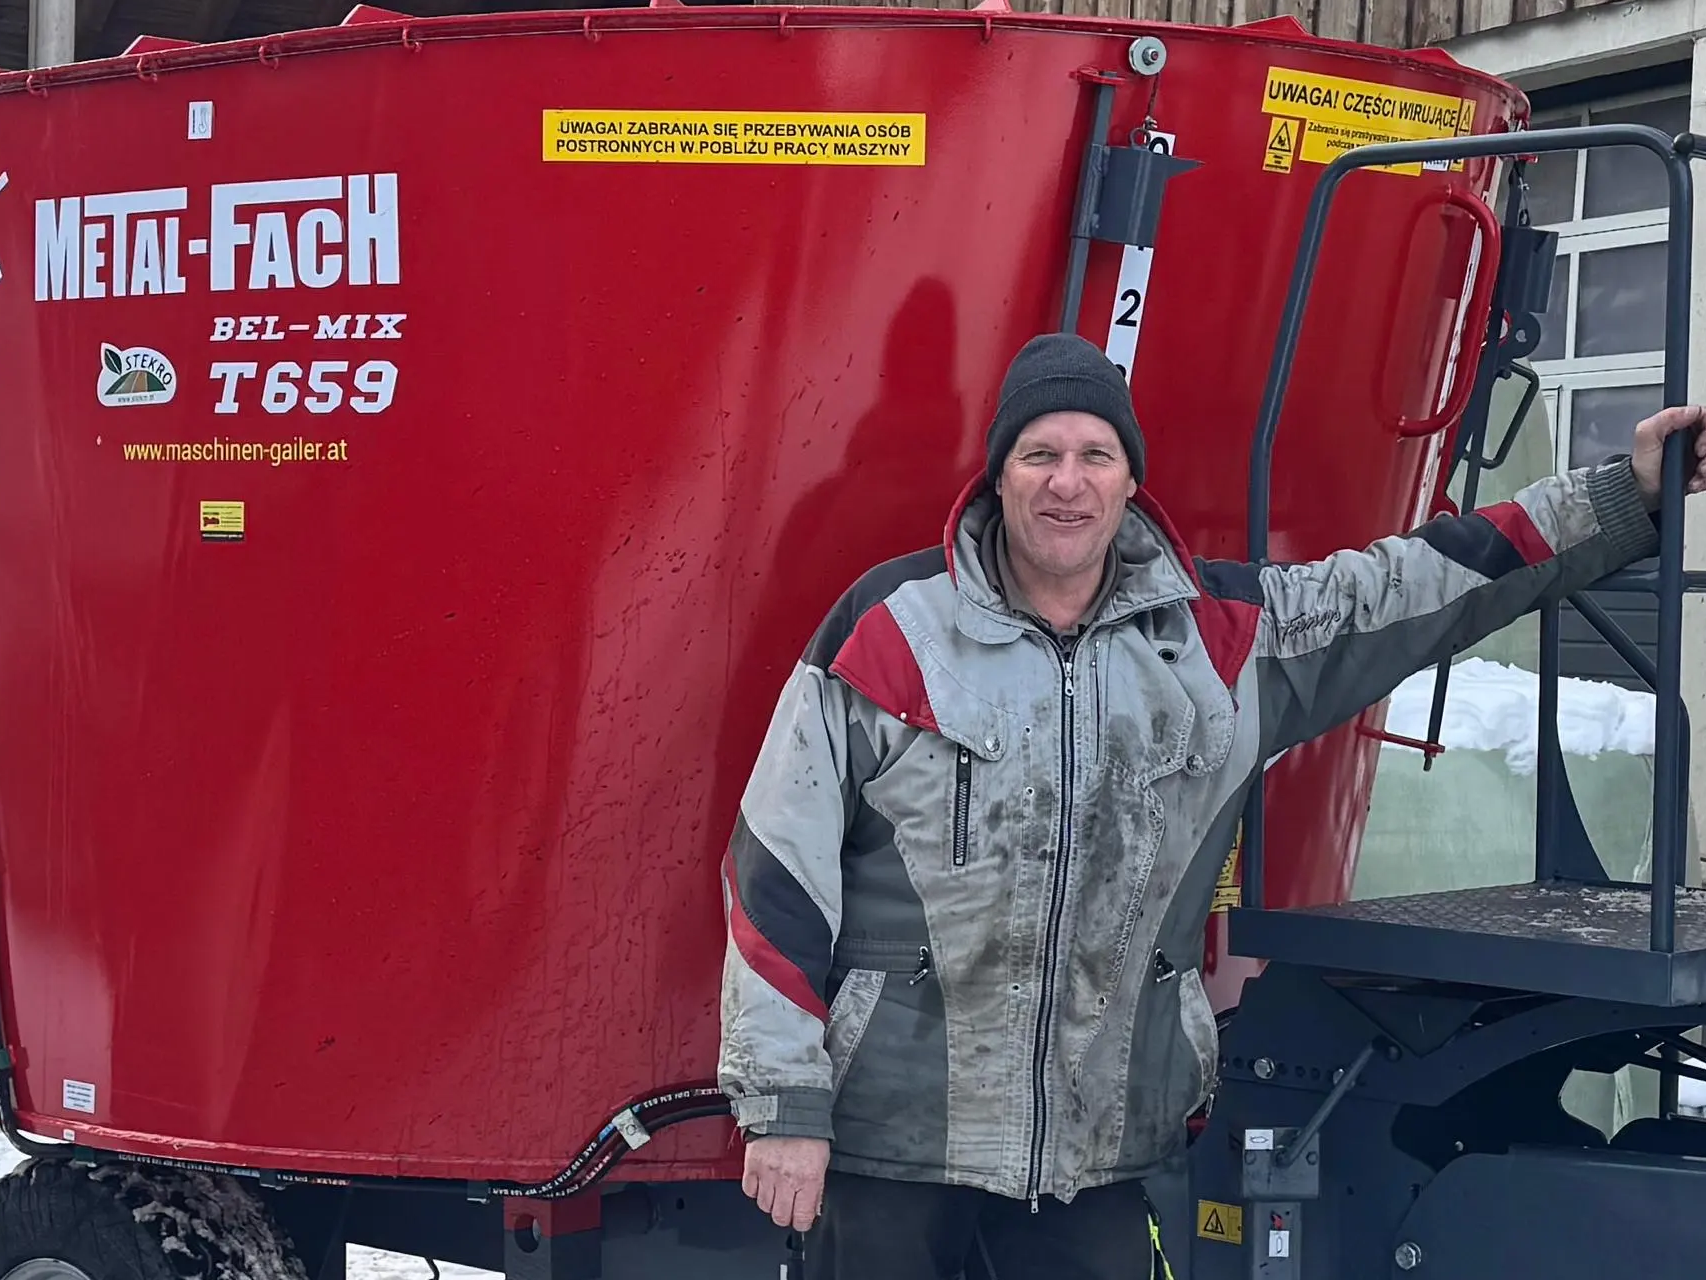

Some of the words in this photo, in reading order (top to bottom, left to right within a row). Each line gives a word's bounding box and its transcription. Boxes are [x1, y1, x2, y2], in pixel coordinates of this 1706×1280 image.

[1268, 79, 1339, 110] UWAGA!
[1342, 91, 1397, 120] CZĘŚCI
[1398, 100, 1458, 131] WIRUJĄCE
[560, 120, 623, 135] UWAGA!
[627, 121, 709, 136] ZABRANIA
[713, 122, 738, 139] SIĘ
[743, 123, 861, 138] PRZEBYWANIA
[865, 121, 911, 138] OSÓB
[556, 138, 675, 154] POSTRONNYCH
[680, 141, 695, 154] W
[699, 138, 768, 156] POBLIŻU
[774, 141, 829, 156] PRACY
[833, 142, 911, 157] MASZYNY
[1114, 288, 1142, 328] 2
[209, 313, 407, 342] BEL-MIX
[125, 352, 173, 386] STEKRO
[208, 359, 399, 415] T659
[122, 437, 349, 466] www.maschinen-gailer.at
